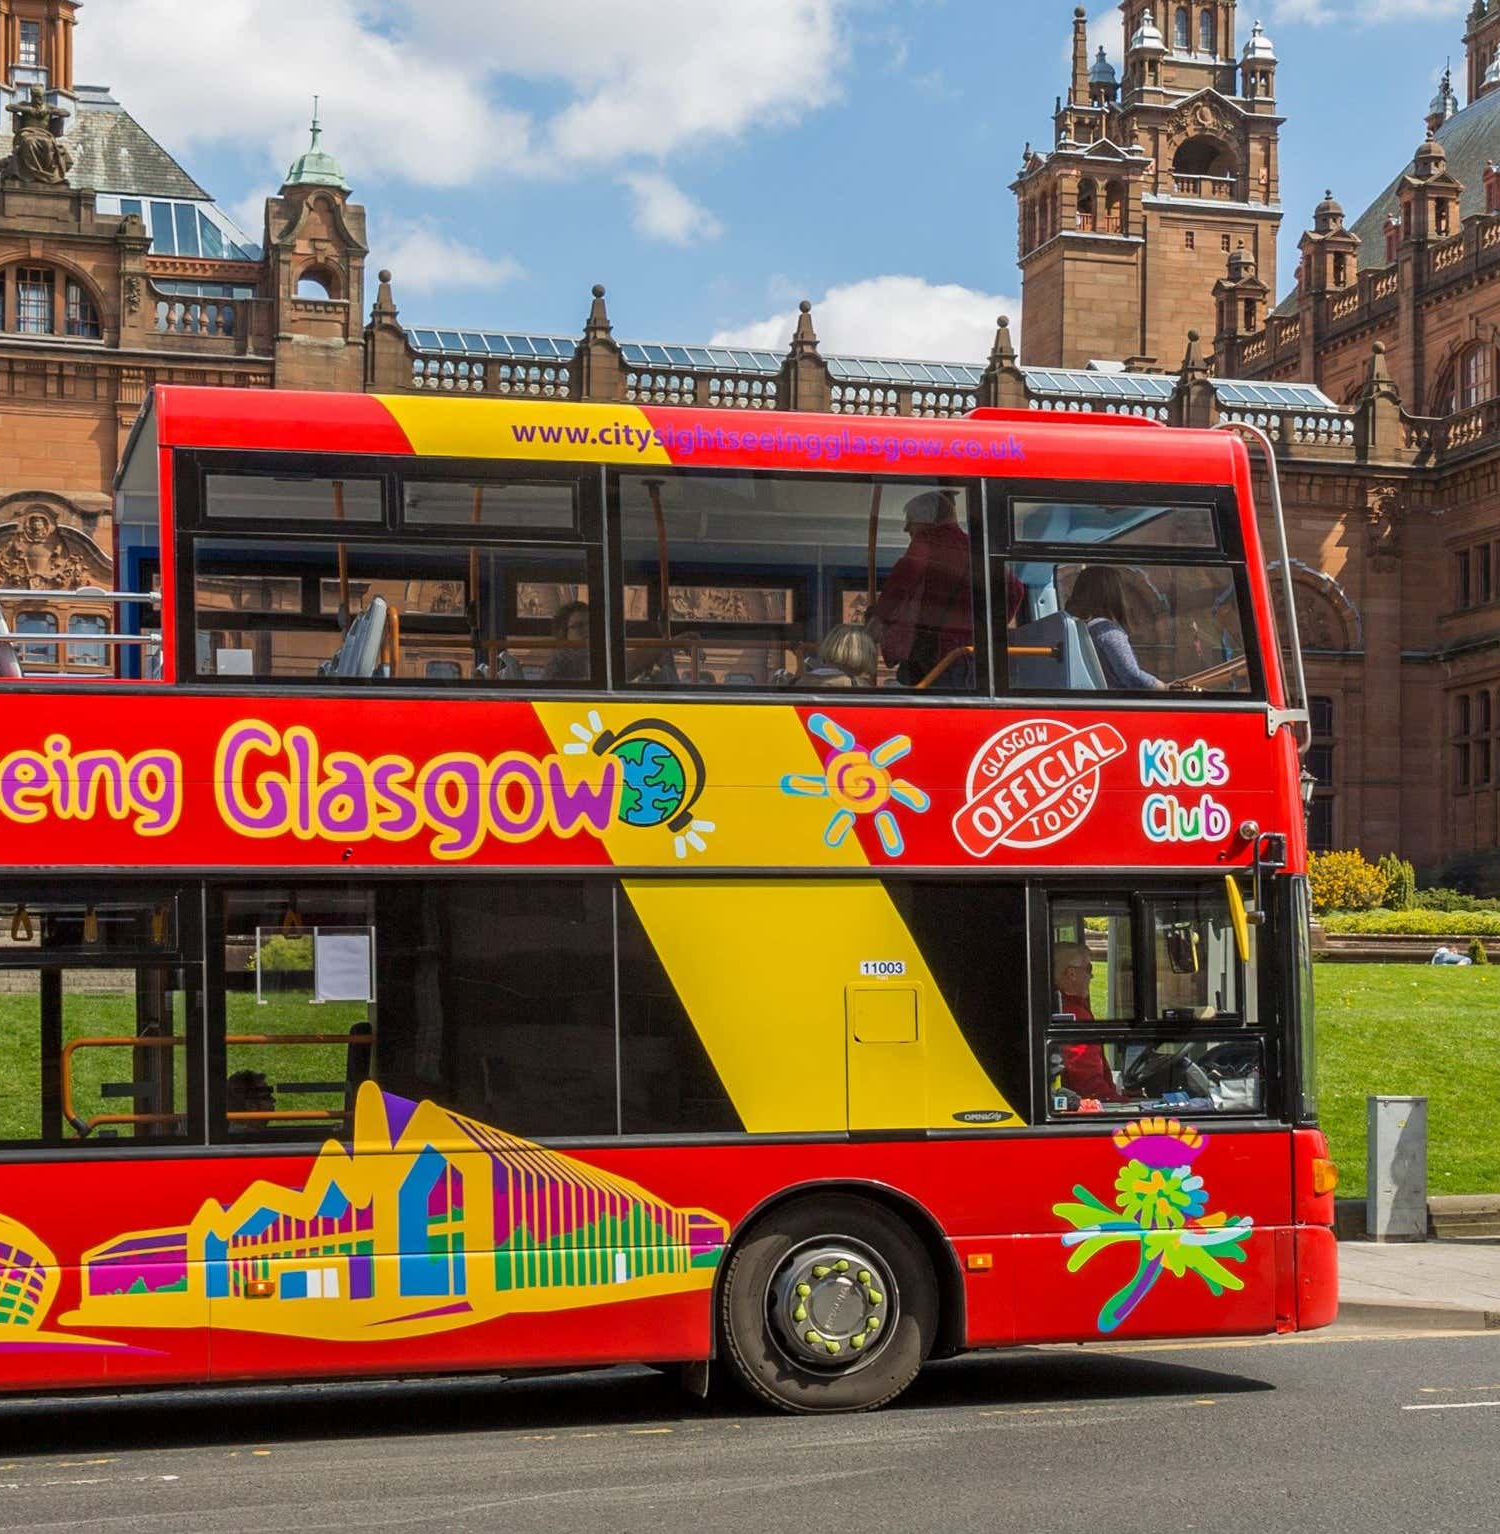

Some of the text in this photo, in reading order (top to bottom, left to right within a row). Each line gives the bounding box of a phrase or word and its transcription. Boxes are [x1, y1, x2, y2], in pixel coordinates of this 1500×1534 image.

[511, 420, 1025, 463] www.citysightseeingglasgow.co.uk
[981, 725, 1048, 777] GLASGOW
[1139, 738, 1230, 787] Kids
[213, 718, 624, 860] Glasgow
[972, 732, 1117, 838] OFFICIAL
[1028, 783, 1092, 836] TOUR
[1141, 793, 1231, 843] Club
[863, 962, 904, 974] 11003
